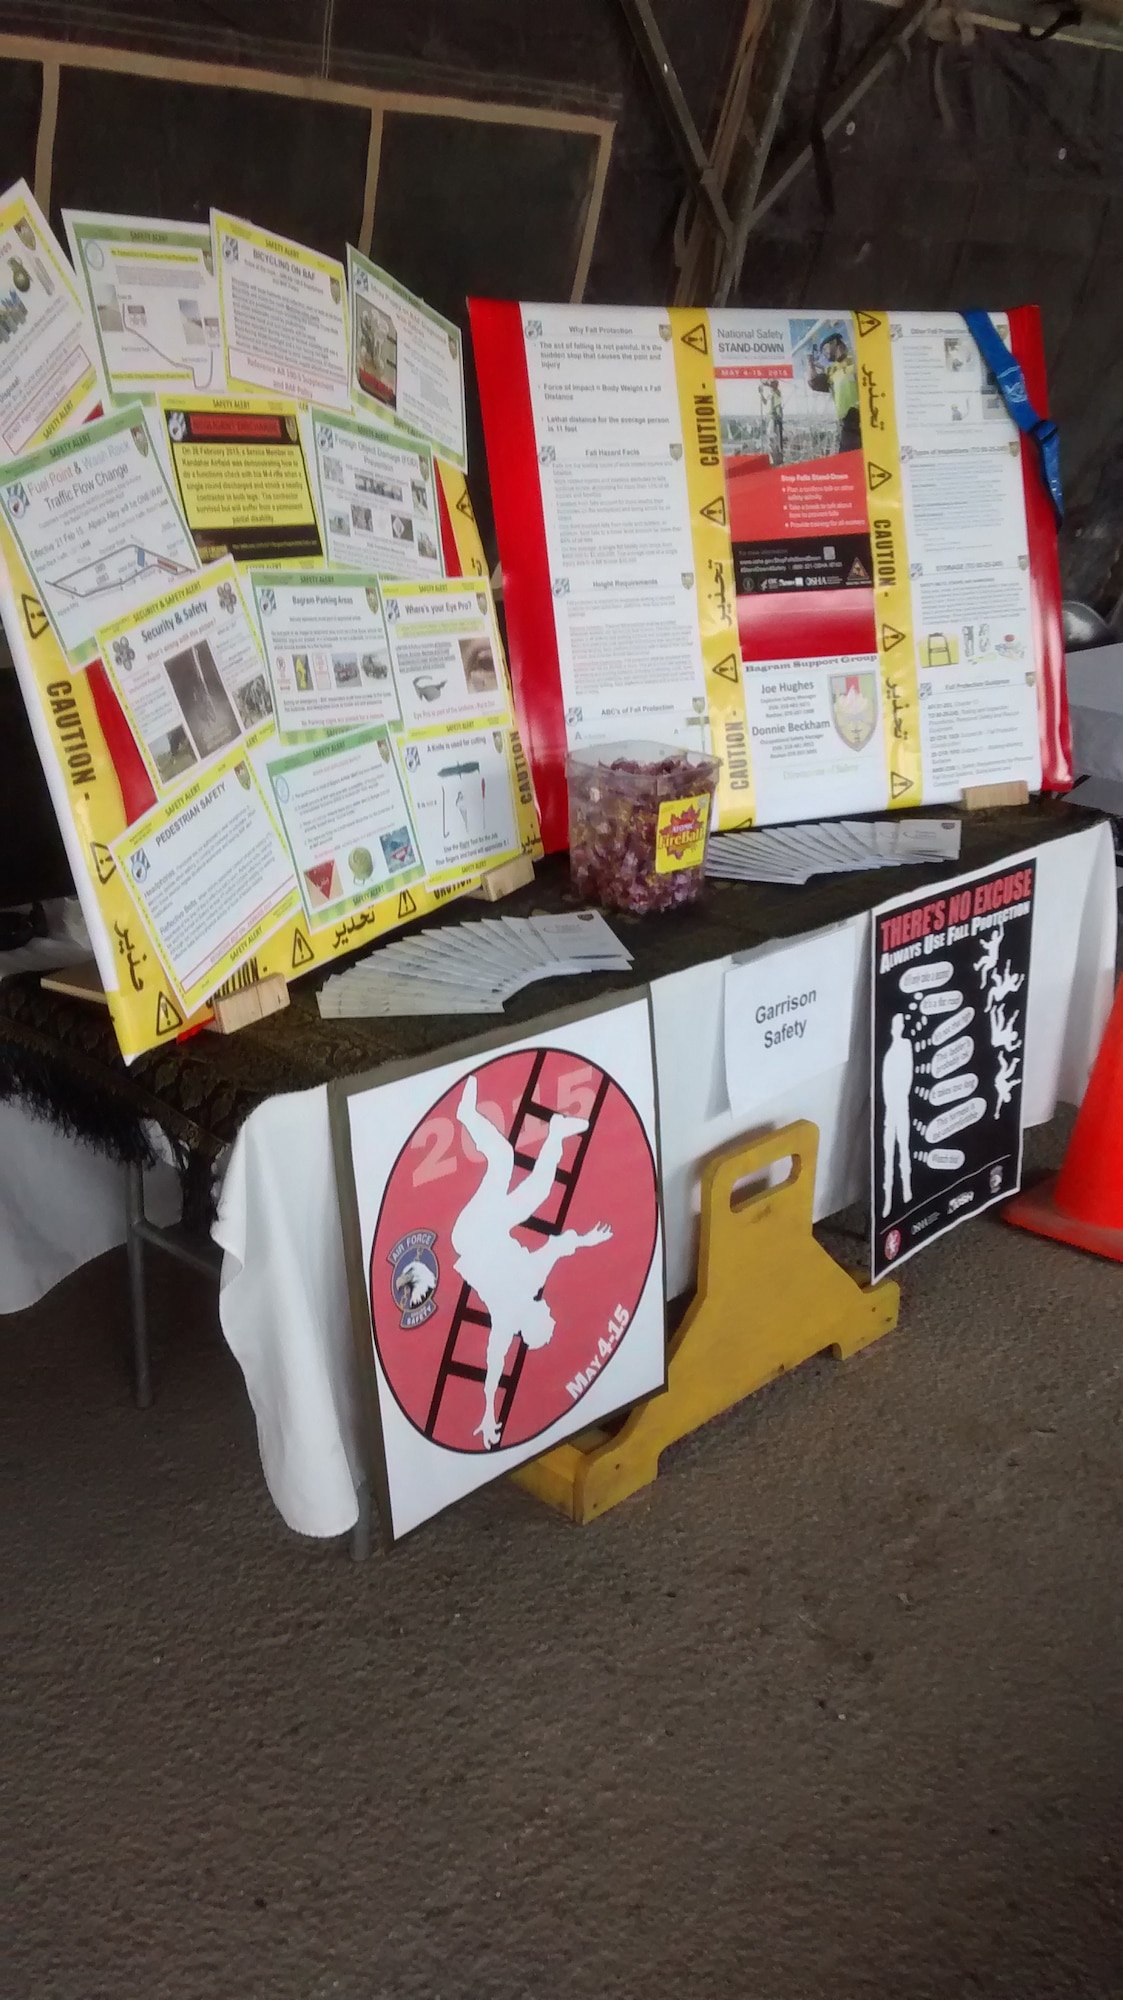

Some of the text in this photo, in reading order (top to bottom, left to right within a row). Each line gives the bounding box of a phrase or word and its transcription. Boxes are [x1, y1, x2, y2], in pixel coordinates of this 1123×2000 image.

[253, 247, 290, 271] BICYCLING
[568, 325, 633, 335] Why Fall Protection
[717, 328, 783, 340] National Safety
[718, 342, 785, 353] STAND-DOWN
[213, 399, 250, 409] SAFETY ALERT
[544, 393, 574, 401] Distance
[569, 416, 597, 424] distance
[694, 394, 720, 466] CAUTION
[49, 432, 91, 457] SAFETY ALERT
[27, 477, 50, 496] Fuel
[48, 466, 74, 487] Point
[73, 461, 82, 475] &
[44, 463, 129, 511] Traffic Flow Change
[873, 518, 897, 587] CAUTION
[300, 575, 335, 584] SAFETY ALERT
[418, 583, 448, 593] SAFETY ALERT
[593, 579, 658, 588] Height Requirements
[805, 576, 827, 586] OSHA
[133, 604, 160, 622] SECURITY
[165, 591, 186, 605] SAFETY
[185, 581, 201, 597] ALERT
[292, 595, 354, 607] Bagram Parking Areas
[405, 600, 472, 615] Where's your Eye Pro?
[141, 600, 209, 643] Security & Safety
[745, 655, 877, 673] Bagram Support Group
[761, 680, 815, 695] Joe Hughes
[601, 707, 621, 716] ABC's
[630, 706, 642, 714] Fall
[642, 704, 675, 713] Protection
[46, 680, 97, 785] CAUTION
[751, 720, 831, 737] Donnie Beckham
[313, 741, 346, 760] SAFETY ALERT
[725, 720, 750, 791] CAUTION
[510, 731, 533, 805] CAUTION
[164, 782, 201, 817] SAFETY ALERT
[155, 782, 226, 848] PEDESTRIAN SAFETY
[461, 860, 487, 873] SAFETY ALERT
[880, 868, 1032, 953] THERE'S NO EXCUSE
[230, 926, 264, 961] SAFETY ALERT
[755, 989, 817, 1024] Garrison
[764, 1019, 807, 1049] Safety
[411, 1065, 597, 1188] 2015
[392, 1232, 432, 1261] AIR FORCE
[407, 1304, 432, 1326] SAFETY
[598, 1303, 630, 1357] 4-15
